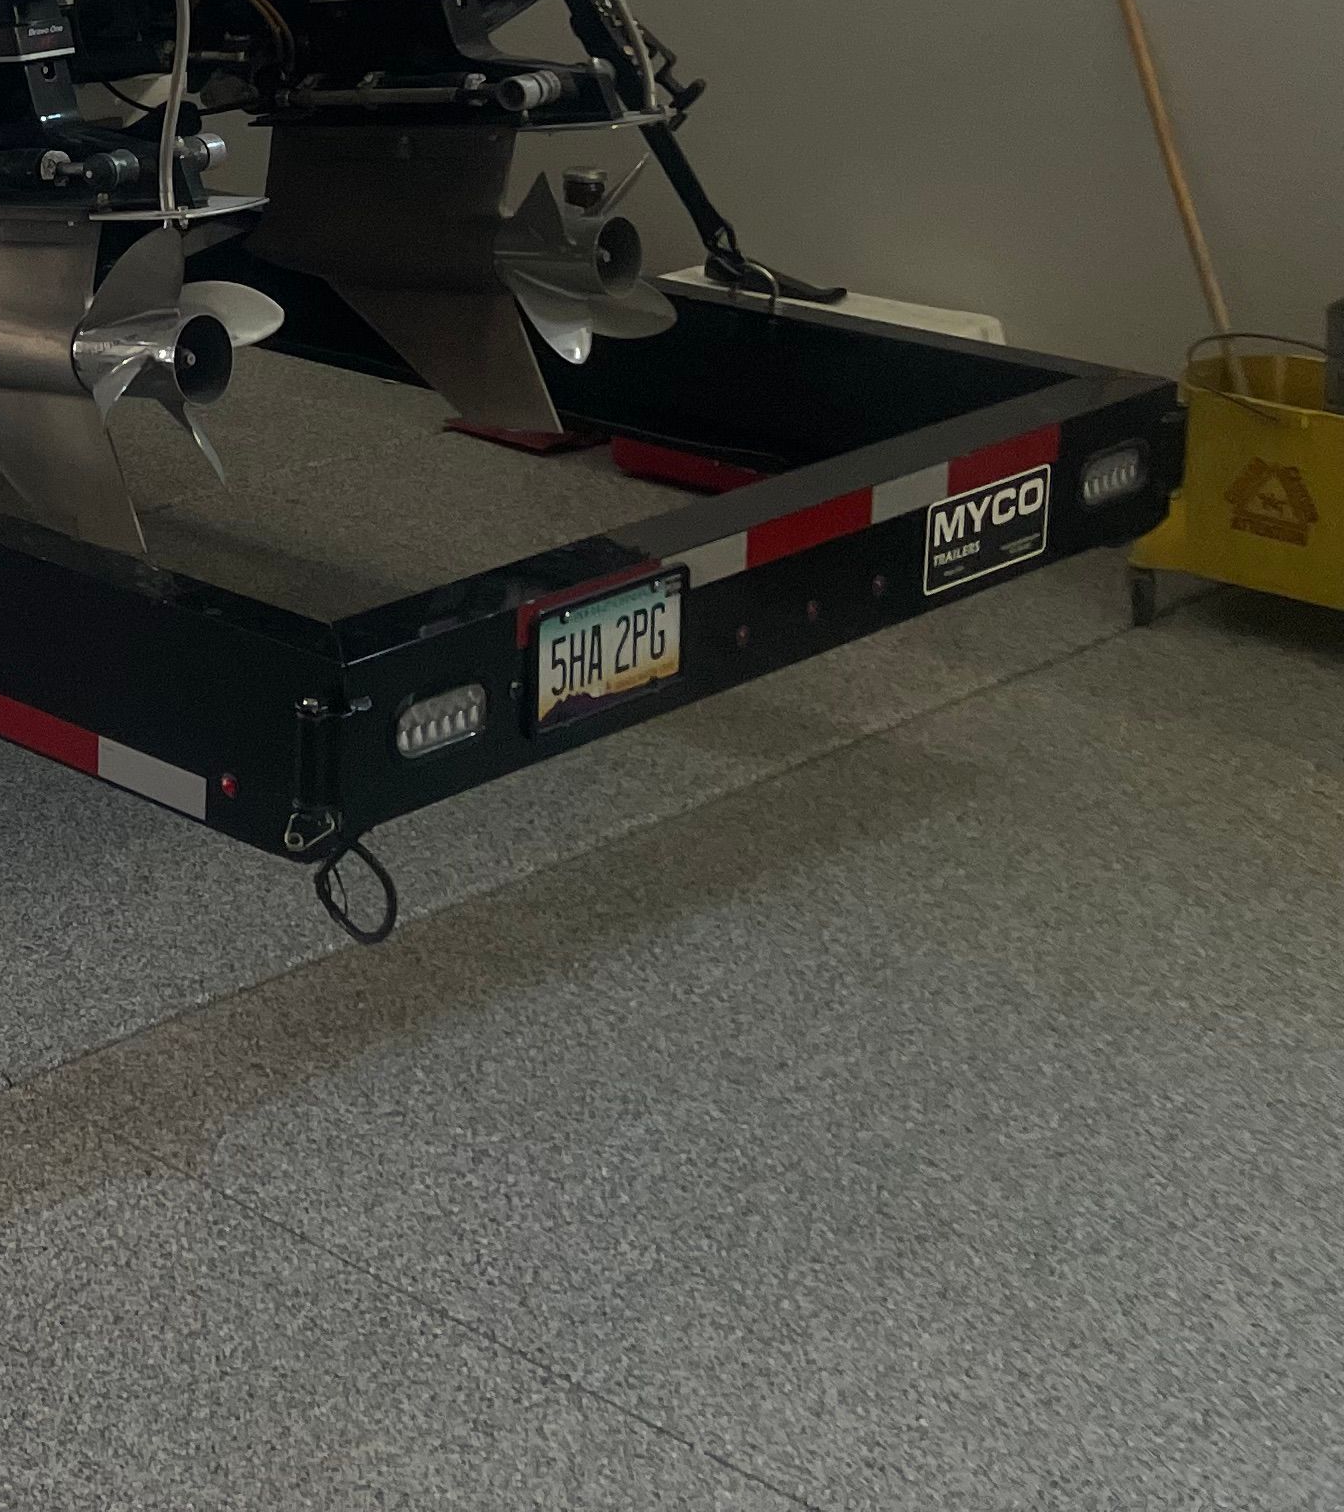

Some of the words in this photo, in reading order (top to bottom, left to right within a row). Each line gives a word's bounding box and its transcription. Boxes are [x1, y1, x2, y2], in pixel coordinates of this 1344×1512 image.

[933, 477, 1045, 548] MYCO
[933, 540, 981, 568] TRAILERS
[551, 623, 604, 697] 5HA
[614, 602, 666, 675] 2PG
